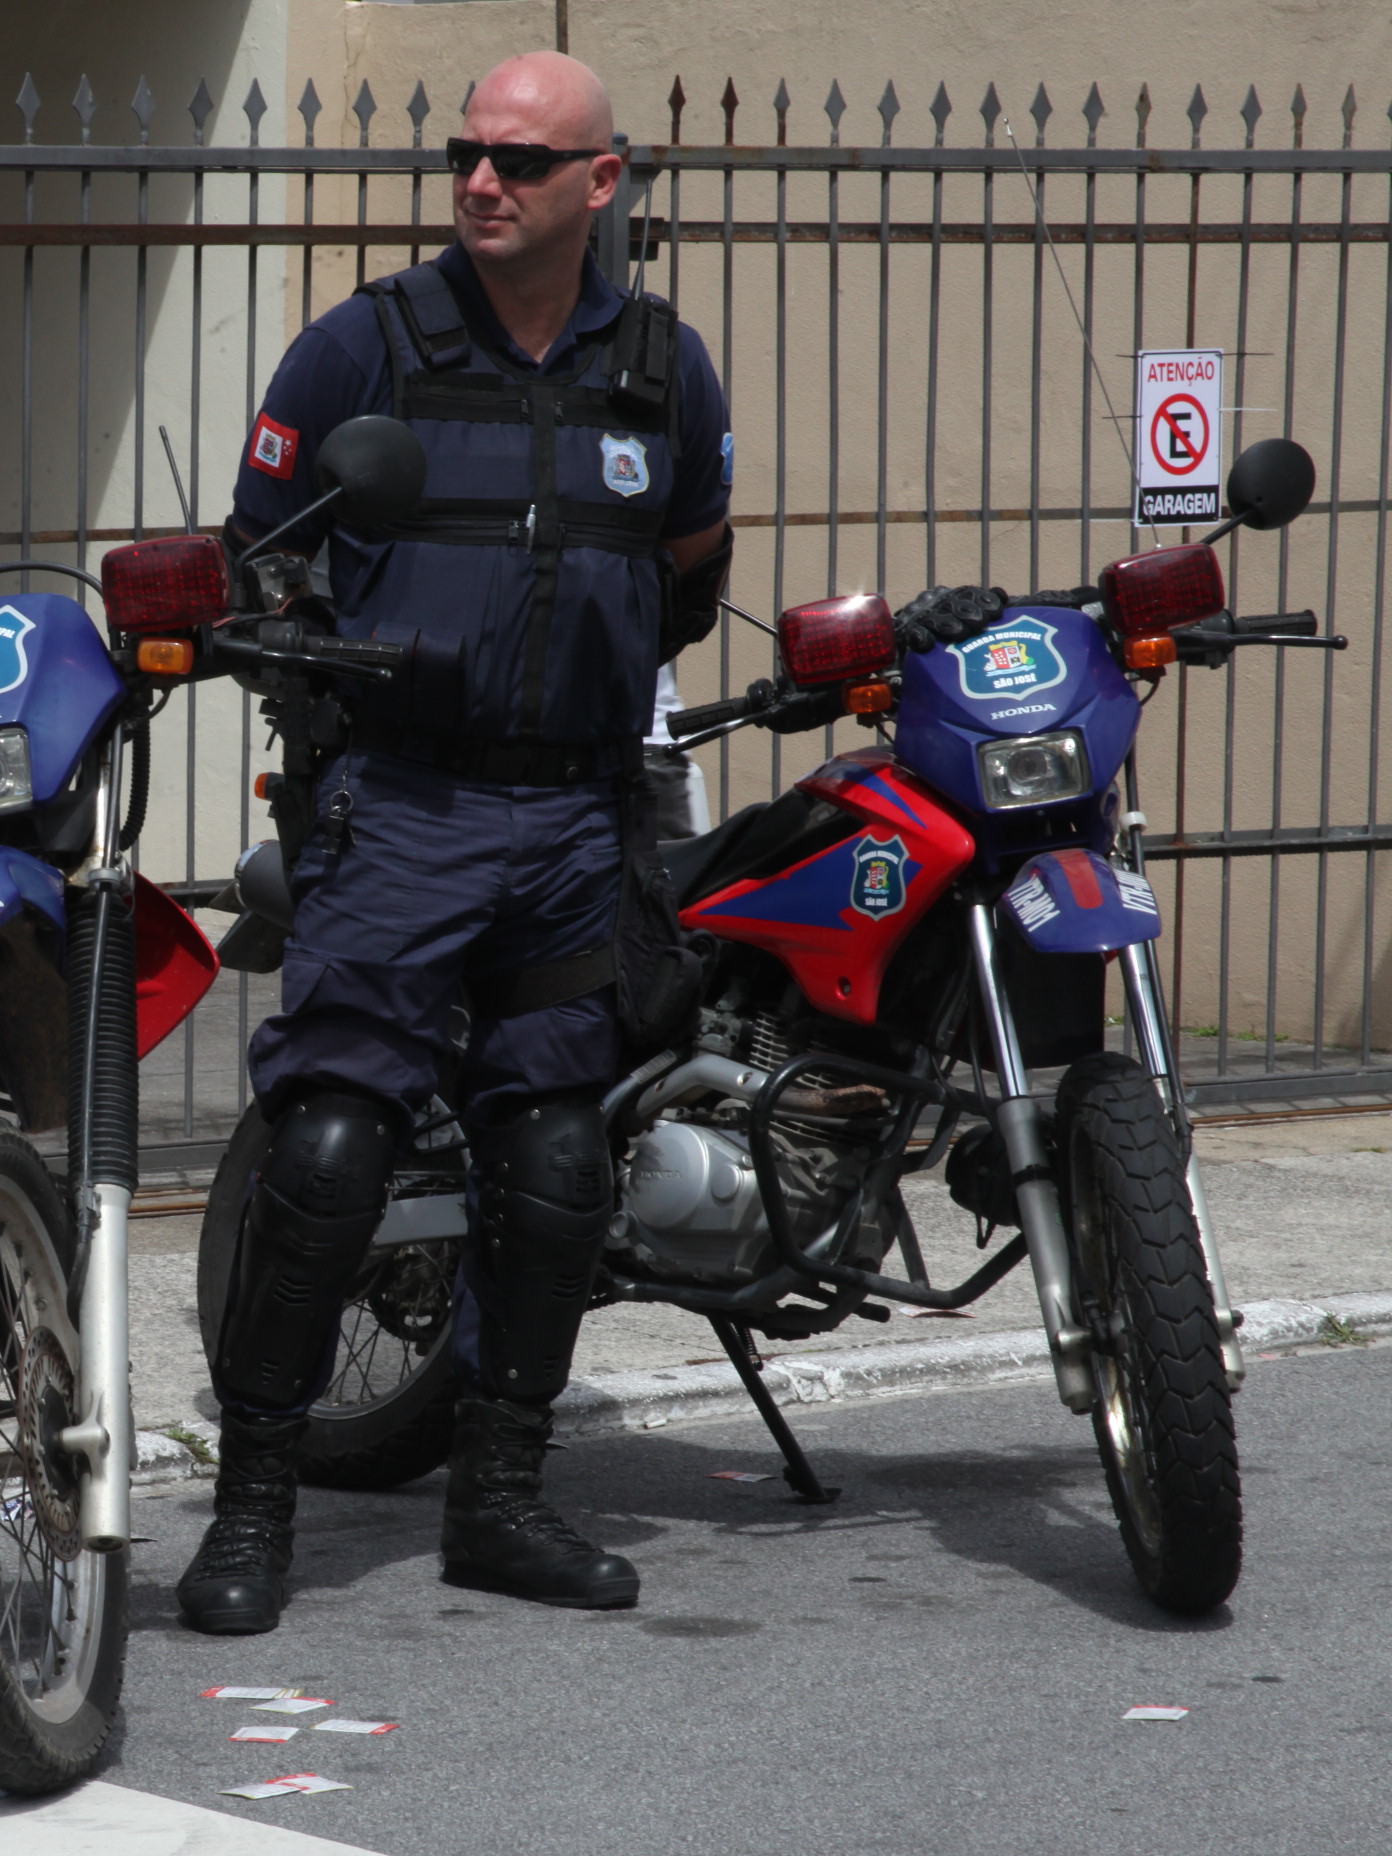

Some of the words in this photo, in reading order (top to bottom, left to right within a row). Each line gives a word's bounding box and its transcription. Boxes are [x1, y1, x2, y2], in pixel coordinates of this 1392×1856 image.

[1147, 357, 1215, 386] ATENÇÃO
[1143, 493, 1216, 516] GARAGEM
[961, 634, 995, 653] GUARDA
[995, 631, 1042, 641] MUNICIPAL
[993, 676, 1013, 689] SÃO
[1014, 672, 1037, 686] JOSÉ
[991, 703, 1057, 720] HONDA
